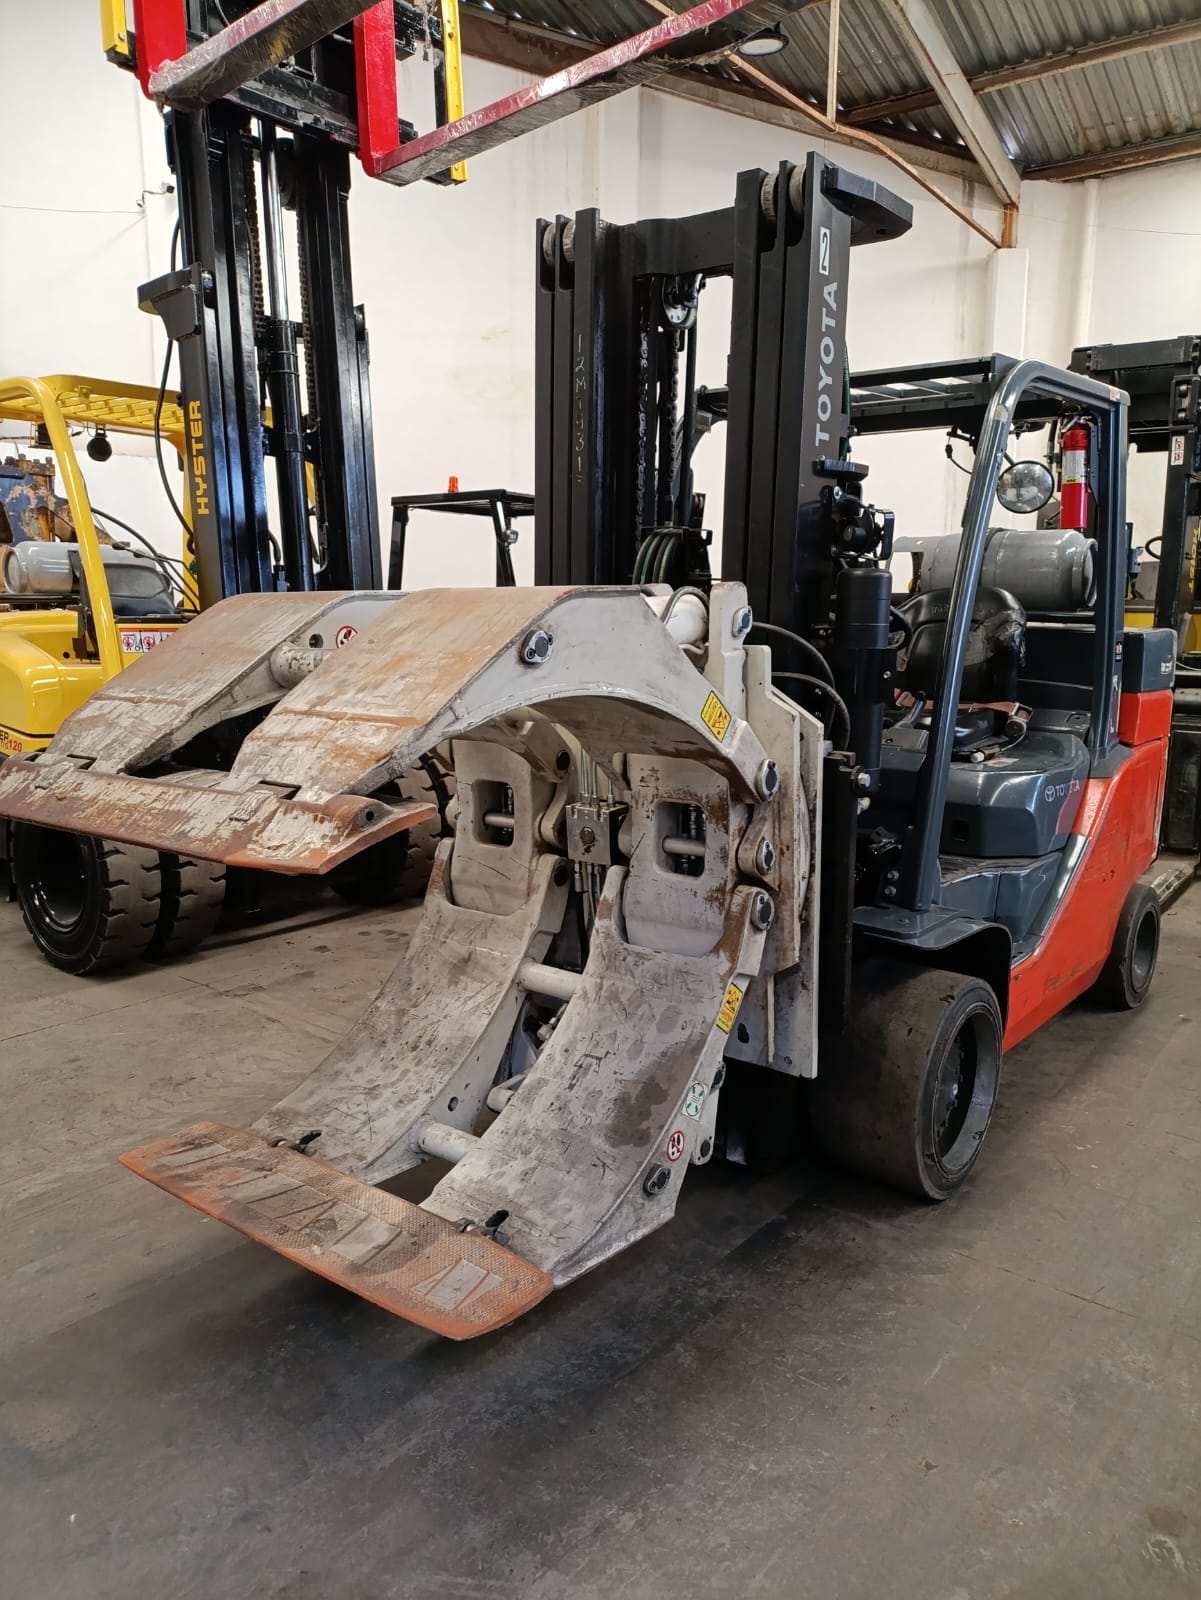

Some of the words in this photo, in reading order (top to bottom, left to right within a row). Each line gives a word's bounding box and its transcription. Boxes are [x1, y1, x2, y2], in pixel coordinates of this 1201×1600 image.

[815, 281, 838, 447] TOYOTA
[188, 400, 209, 515] HYSTER
[9, 739, 22, 752] 120
